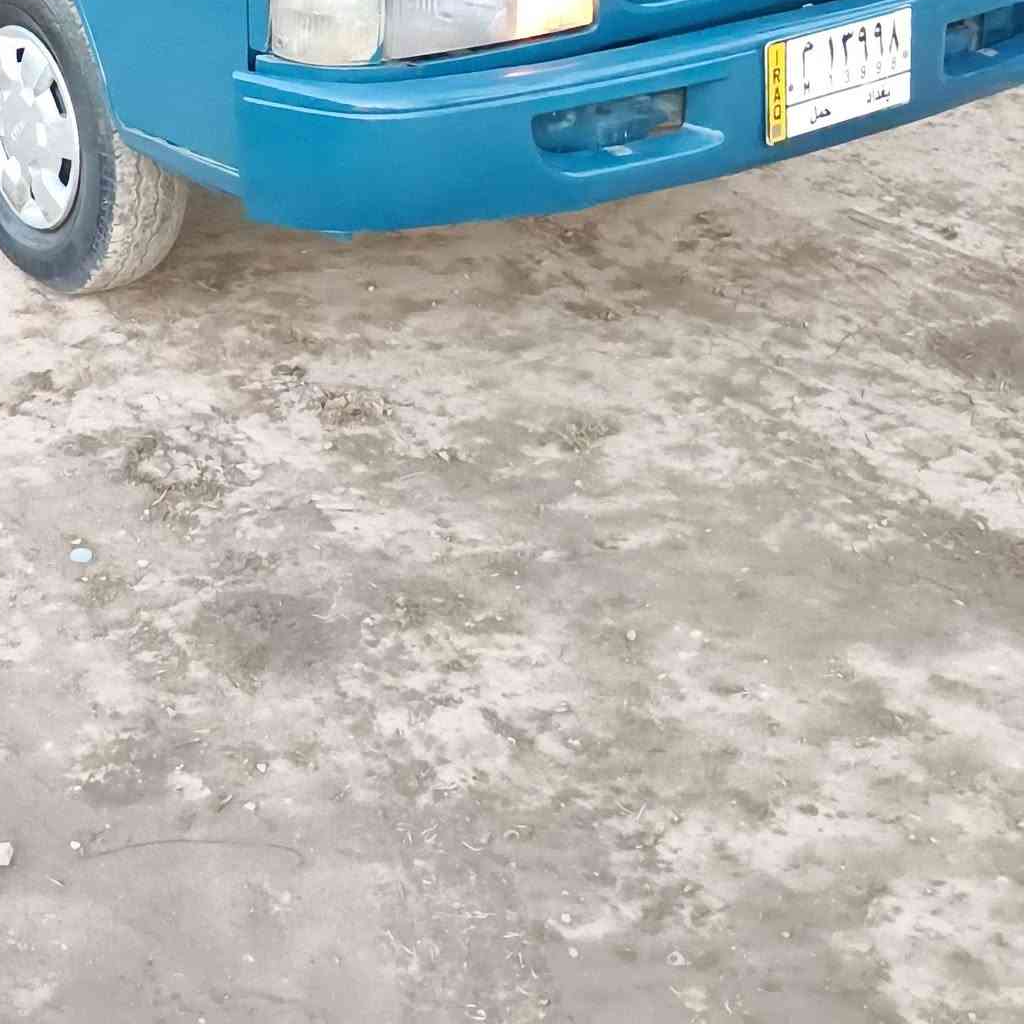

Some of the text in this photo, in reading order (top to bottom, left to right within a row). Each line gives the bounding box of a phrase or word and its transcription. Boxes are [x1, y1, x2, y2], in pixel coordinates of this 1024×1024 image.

[828, 19, 899, 70] ١٣٩٩٨
[773, 50, 782, 121] IRAQ
[809, 105, 832, 125] حمل
